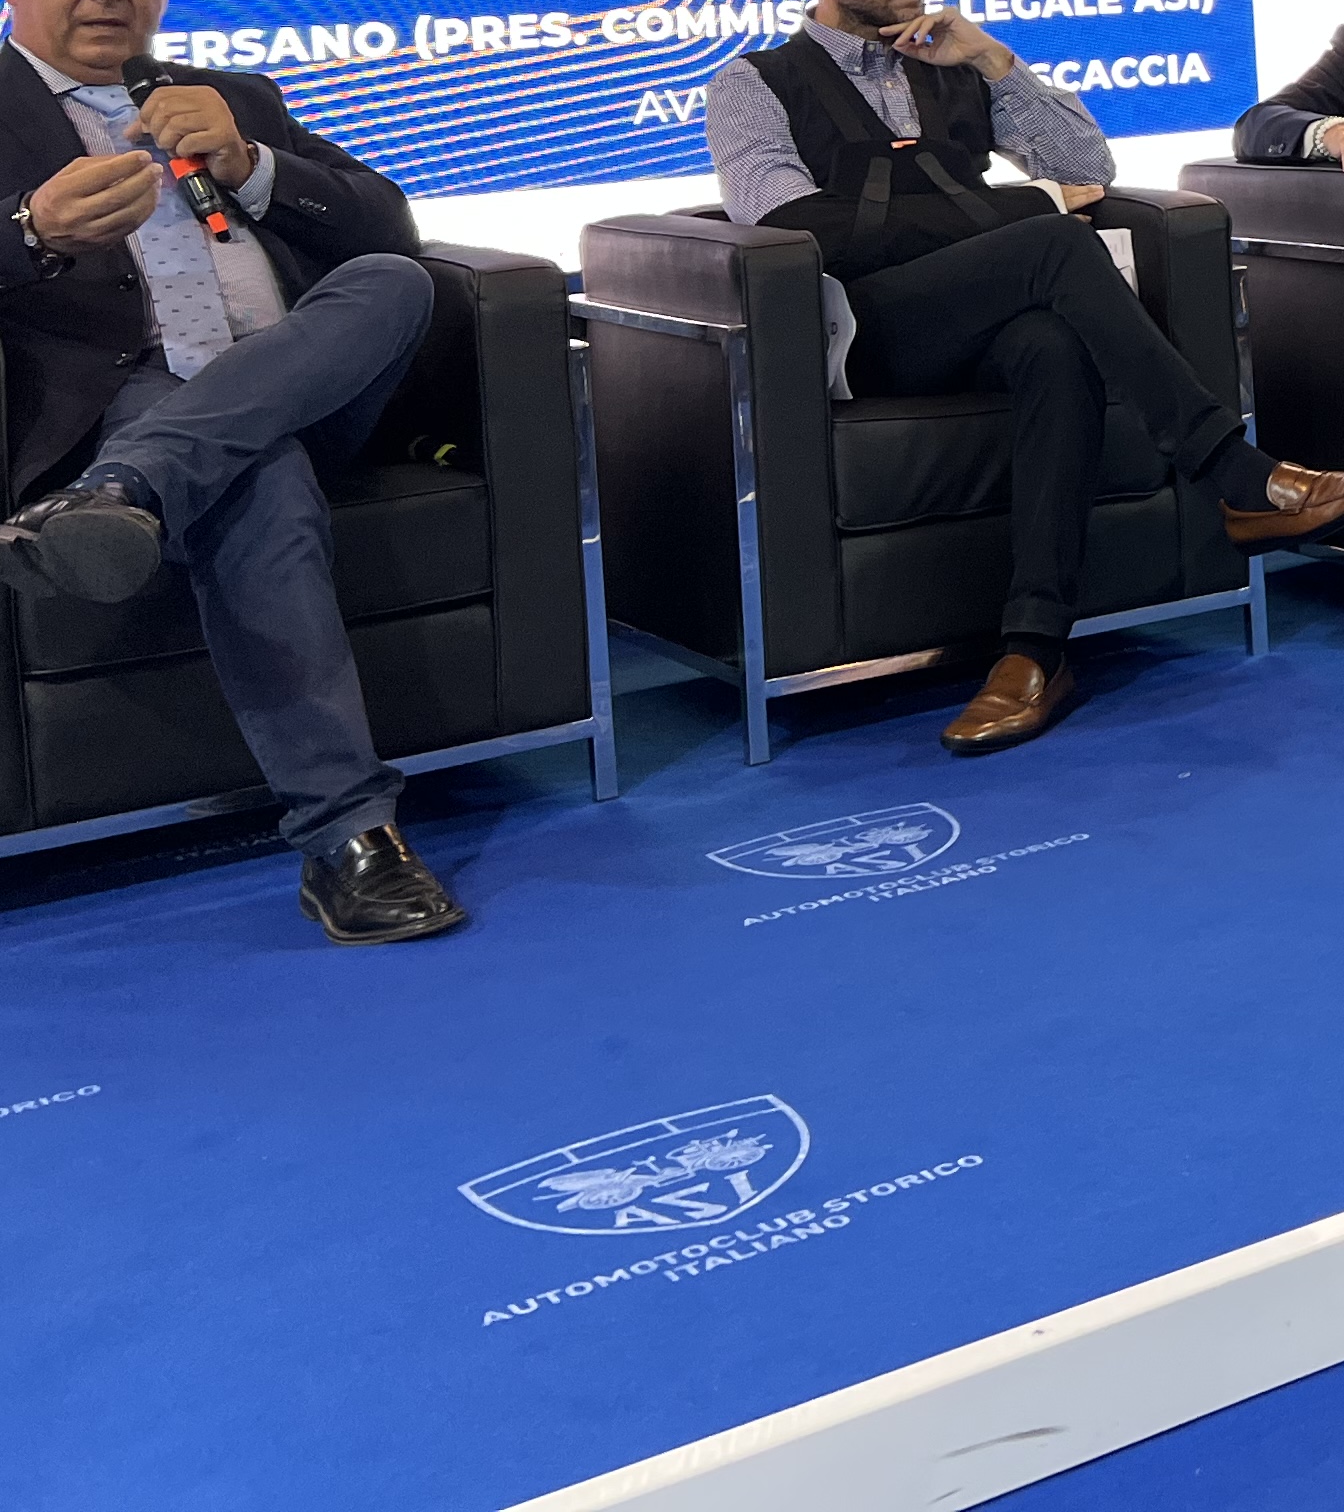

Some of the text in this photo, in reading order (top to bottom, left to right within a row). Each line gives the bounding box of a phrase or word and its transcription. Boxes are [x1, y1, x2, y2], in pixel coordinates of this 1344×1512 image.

[415, 10, 587, 60] (PRES.
[743, 832, 1091, 928] AUTOMOTOCLUB STORICO
[868, 864, 998, 904] ITALIANO
[482, 1154, 985, 1327] AUTOMOTOCLUB STORICO
[662, 1213, 852, 1284] ITALIANO
